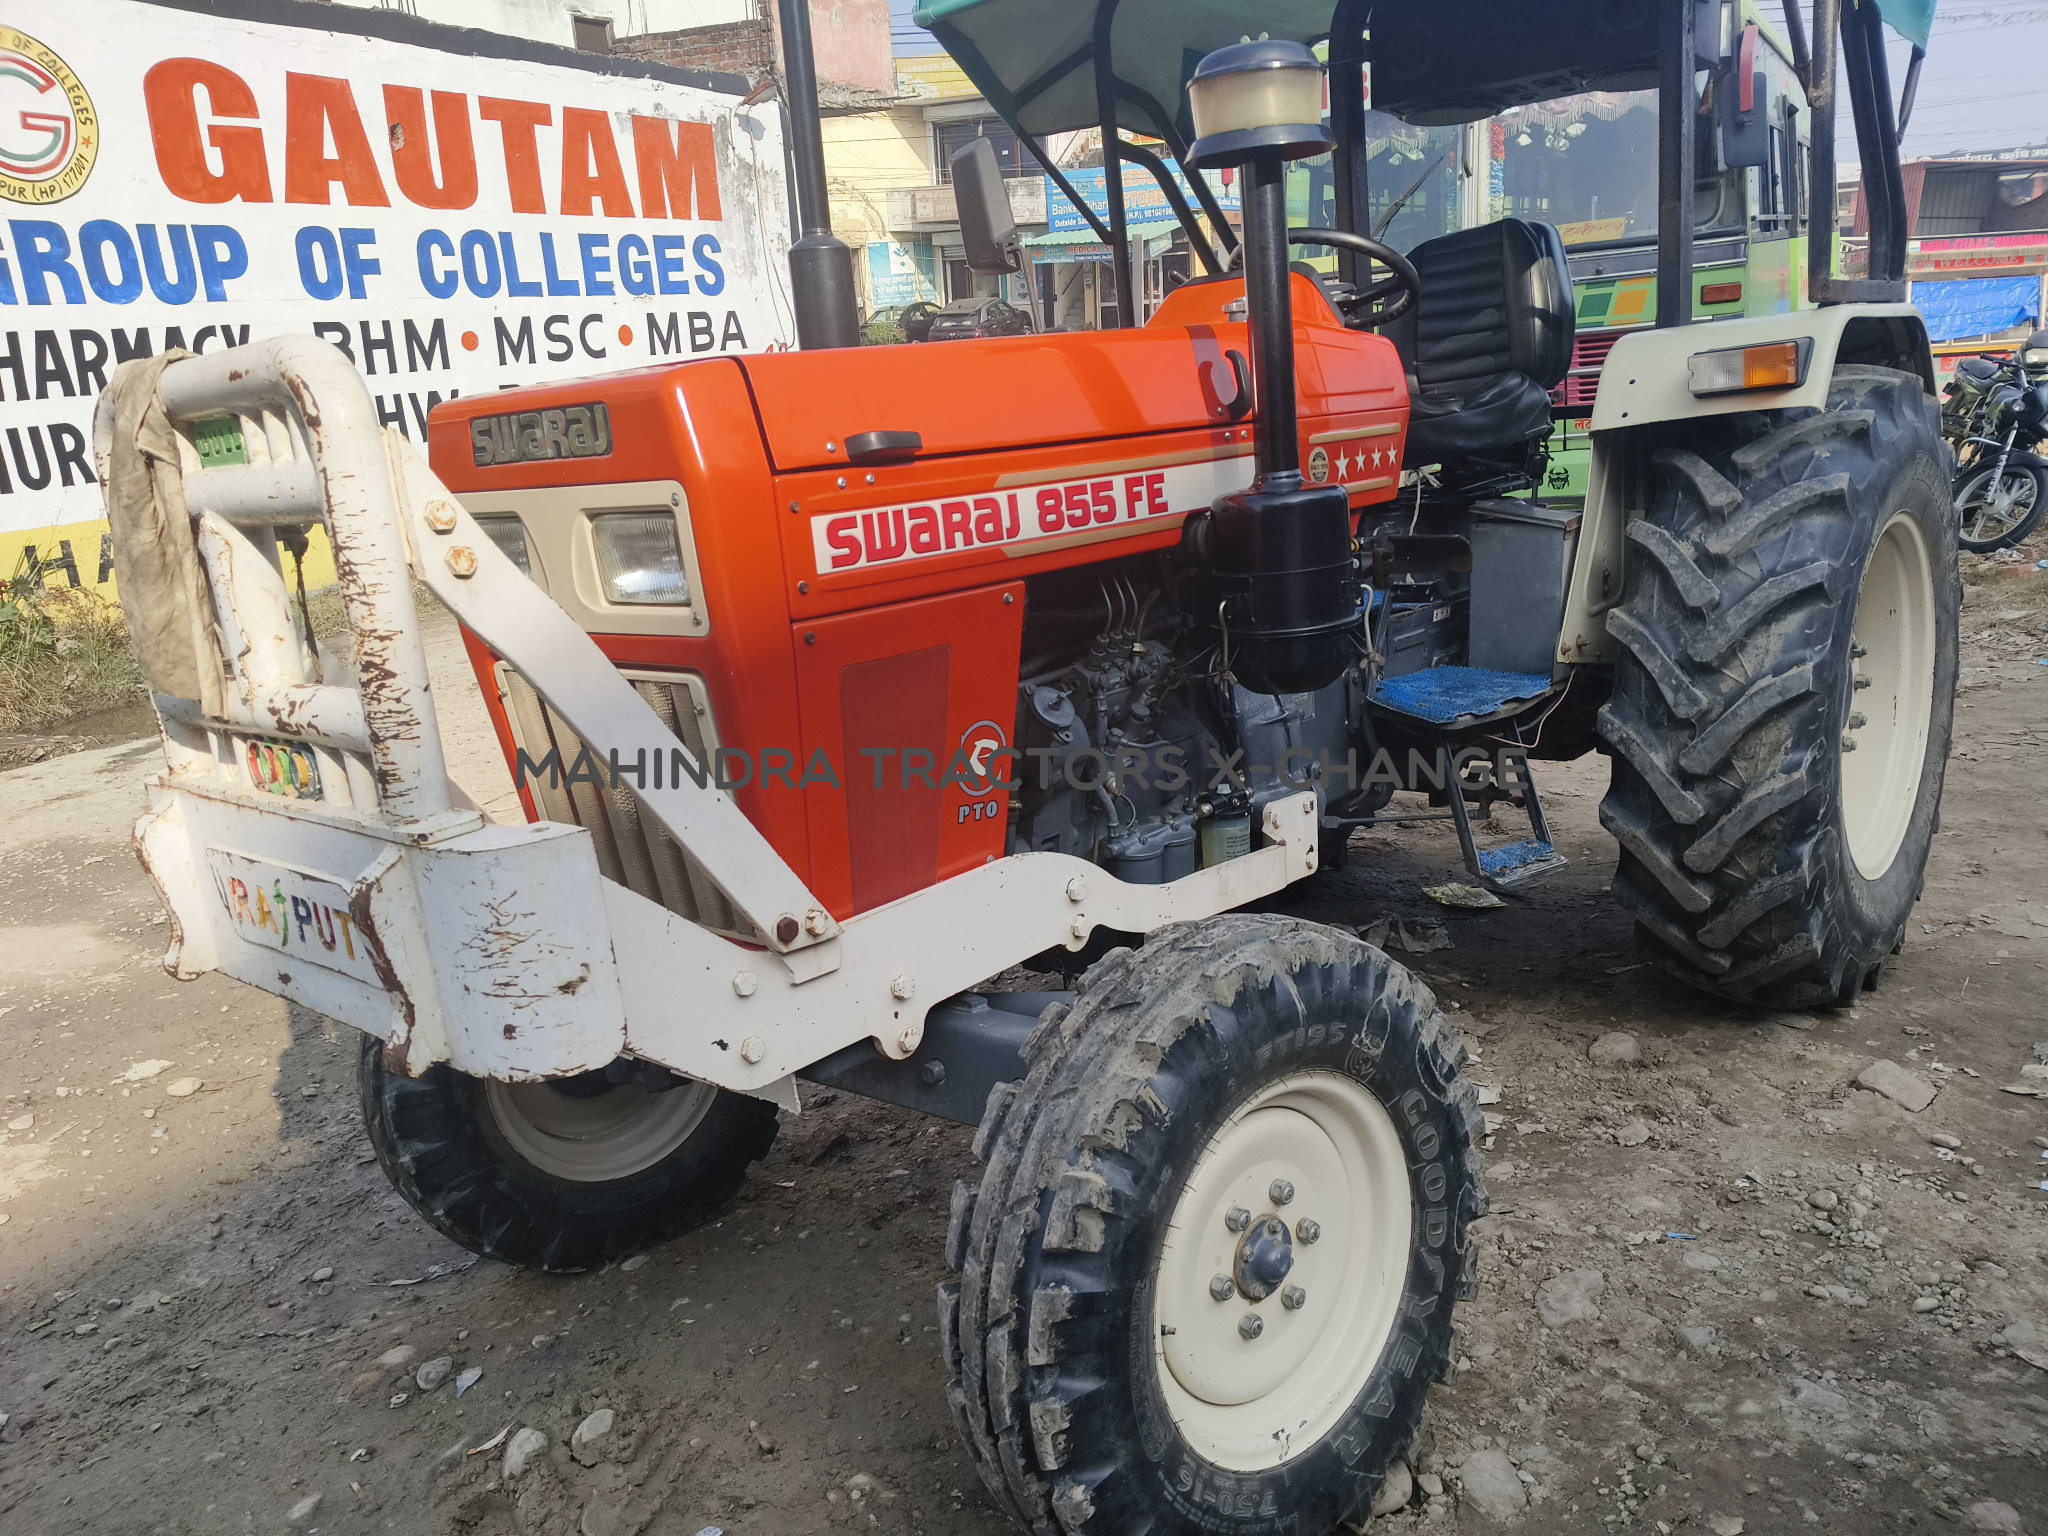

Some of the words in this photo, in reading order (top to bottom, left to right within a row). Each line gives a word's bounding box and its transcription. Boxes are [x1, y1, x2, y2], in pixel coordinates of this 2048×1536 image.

[12, 34, 33, 51] OF
[36, 51, 94, 127] COLLEGES
[143, 57, 722, 221] GAUTAM
[0, 219, 249, 305] ROUP
[295, 226, 381, 300] OF
[417, 229, 725, 299] COLLEGES
[1066, 244, 1102, 254] MEDICAL
[1940, 253, 2020, 268] WELCOME
[494, 313, 607, 365] MSC
[646, 310, 748, 356] MBA
[1036, 481, 1117, 533] 855
[1124, 472, 1169, 518] FE
[957, 800, 999, 824] PTO
[228, 876, 356, 962] RAJPUT
